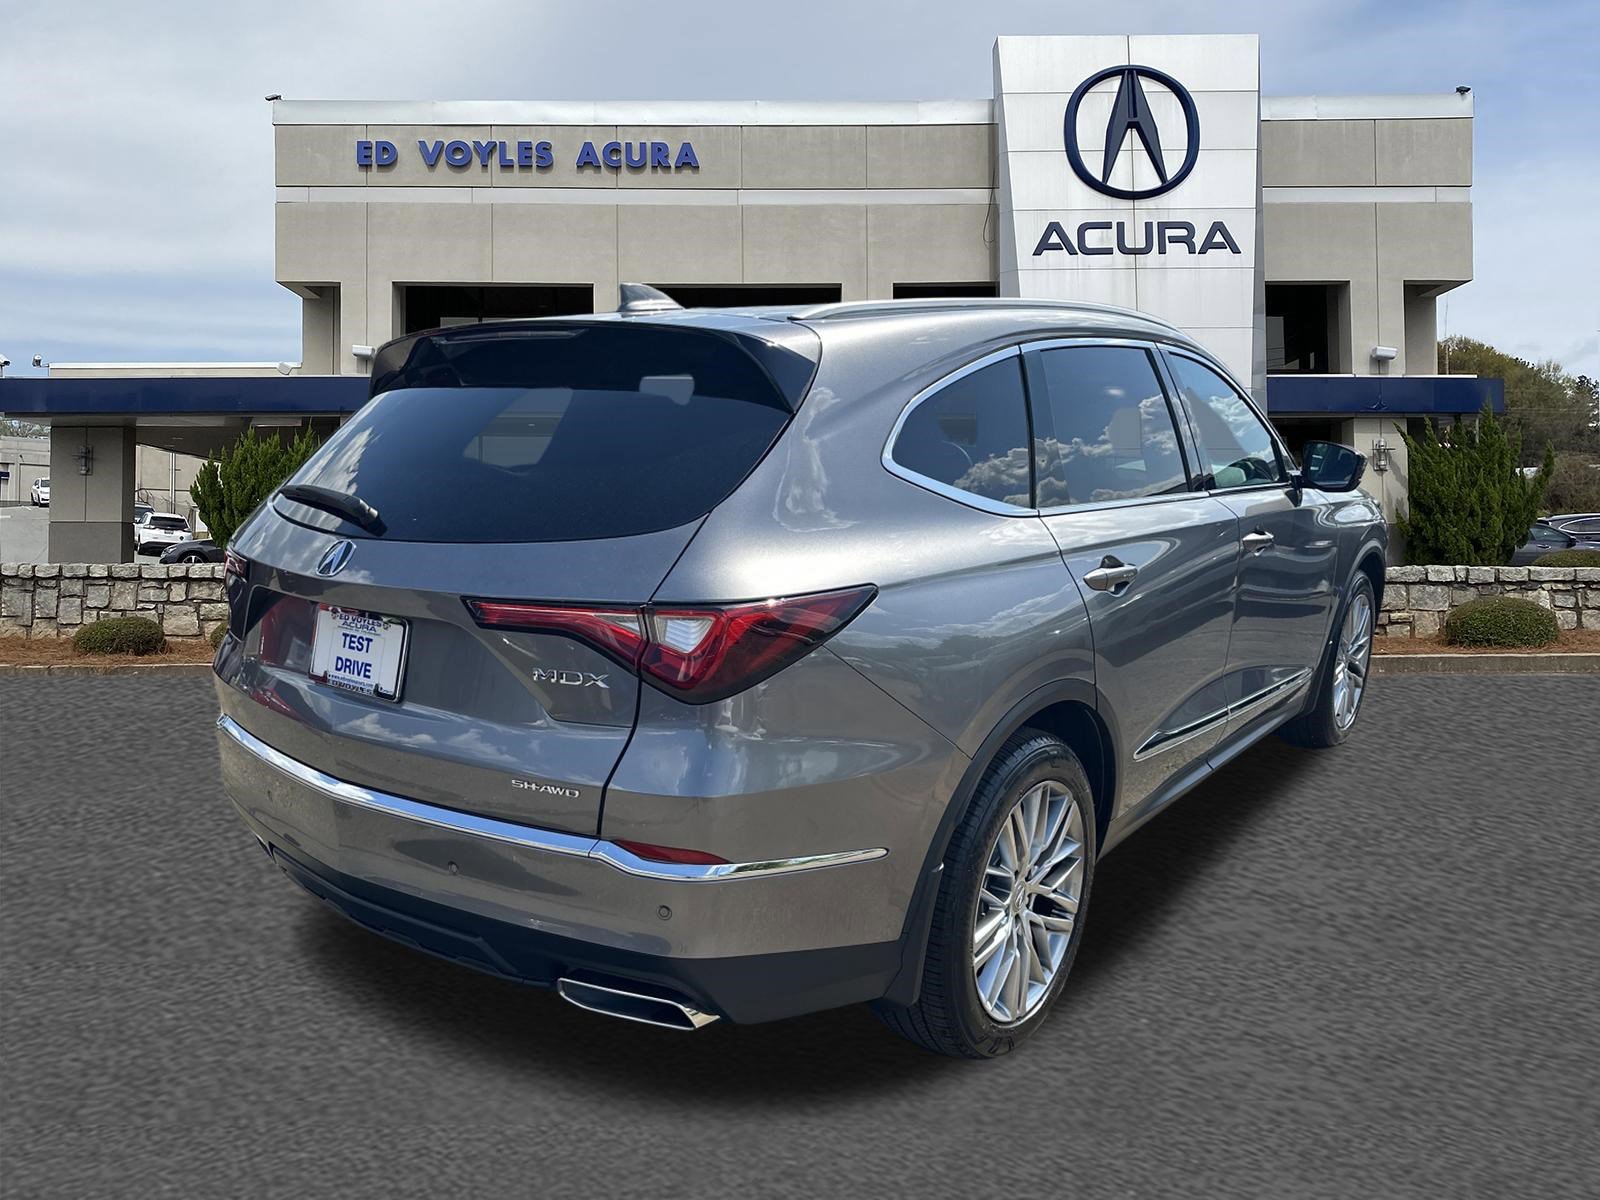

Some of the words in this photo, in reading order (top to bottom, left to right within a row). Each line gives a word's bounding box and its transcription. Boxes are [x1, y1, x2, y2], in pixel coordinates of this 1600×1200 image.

[356, 140, 397, 167] ED
[418, 140, 554, 168] VOYLES
[576, 141, 700, 168] ACURA
[1032, 221, 1242, 256] ACURA
[342, 632, 373, 653] TEST
[335, 656, 372, 679] DRIVE
[532, 667, 610, 688] MDX
[511, 779, 580, 798] SH-AWD
